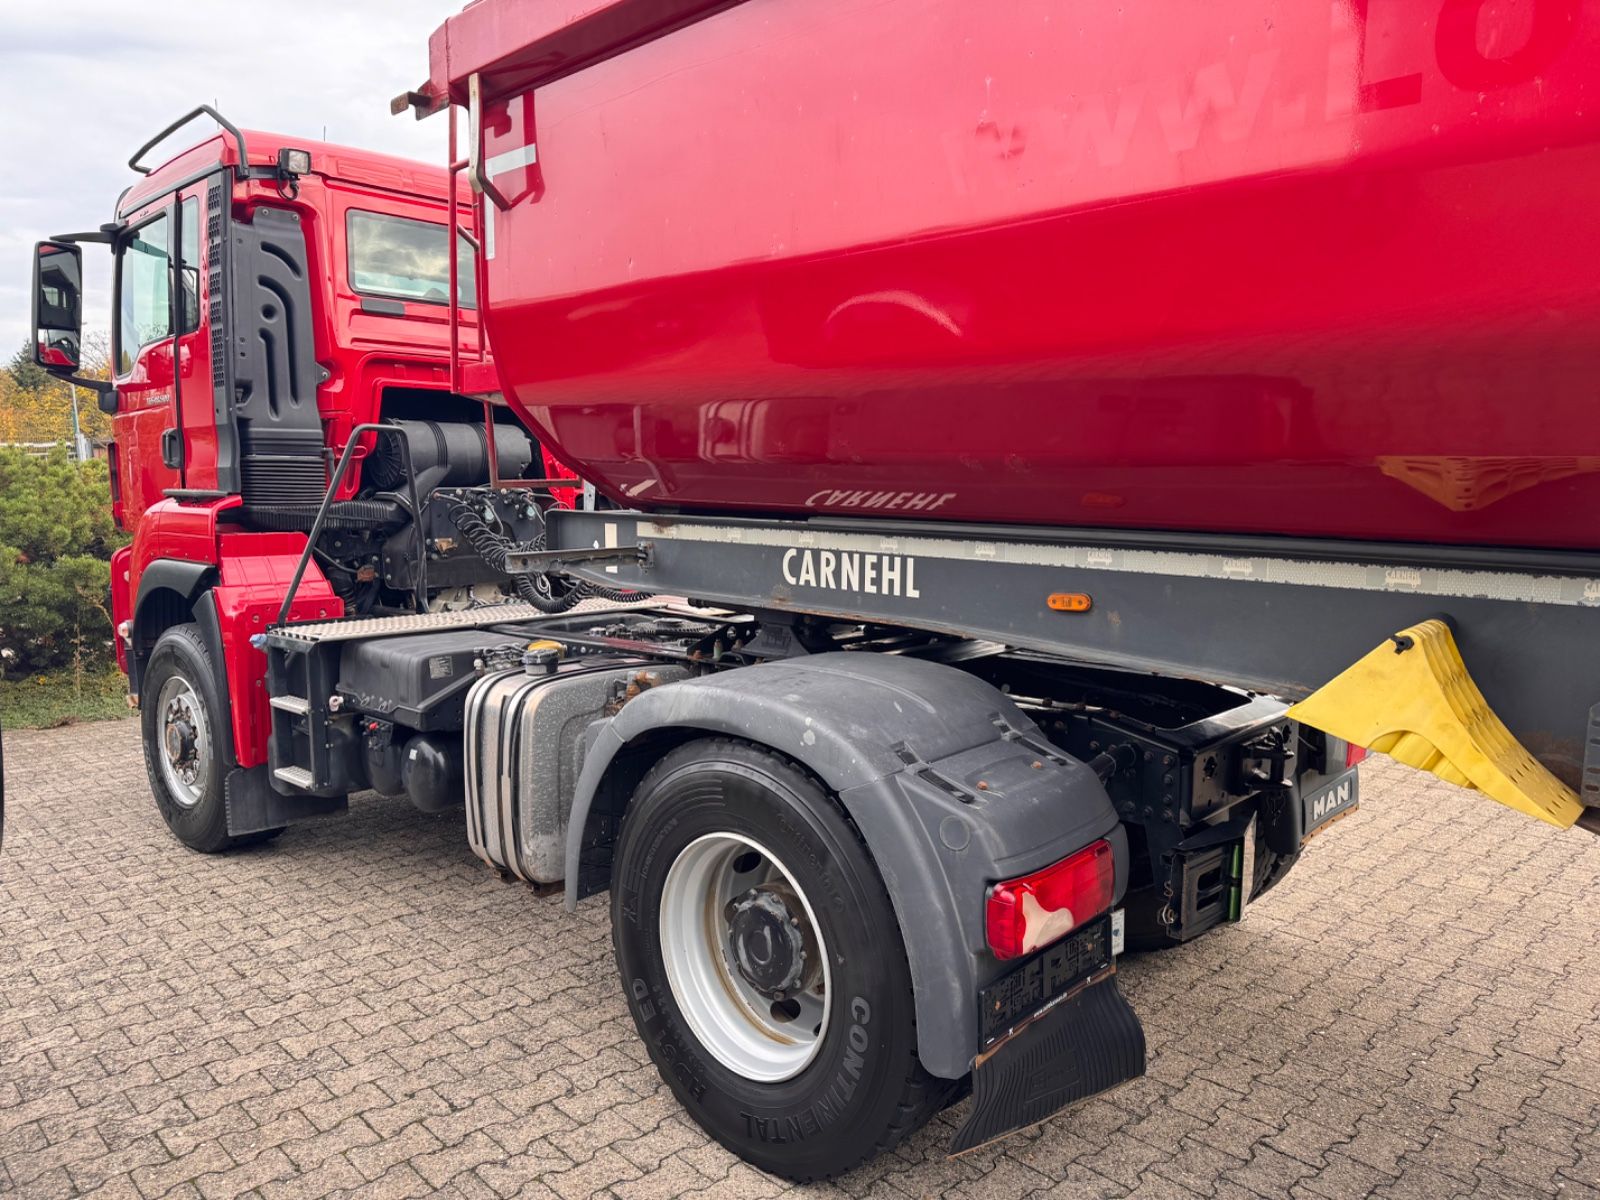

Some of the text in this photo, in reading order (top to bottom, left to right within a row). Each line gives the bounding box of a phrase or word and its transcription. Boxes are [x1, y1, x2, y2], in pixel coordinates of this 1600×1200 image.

[782, 548, 920, 598] CARNEHL
[1313, 781, 1349, 821] MAN
[740, 996, 871, 1145] CONTINENTAL
